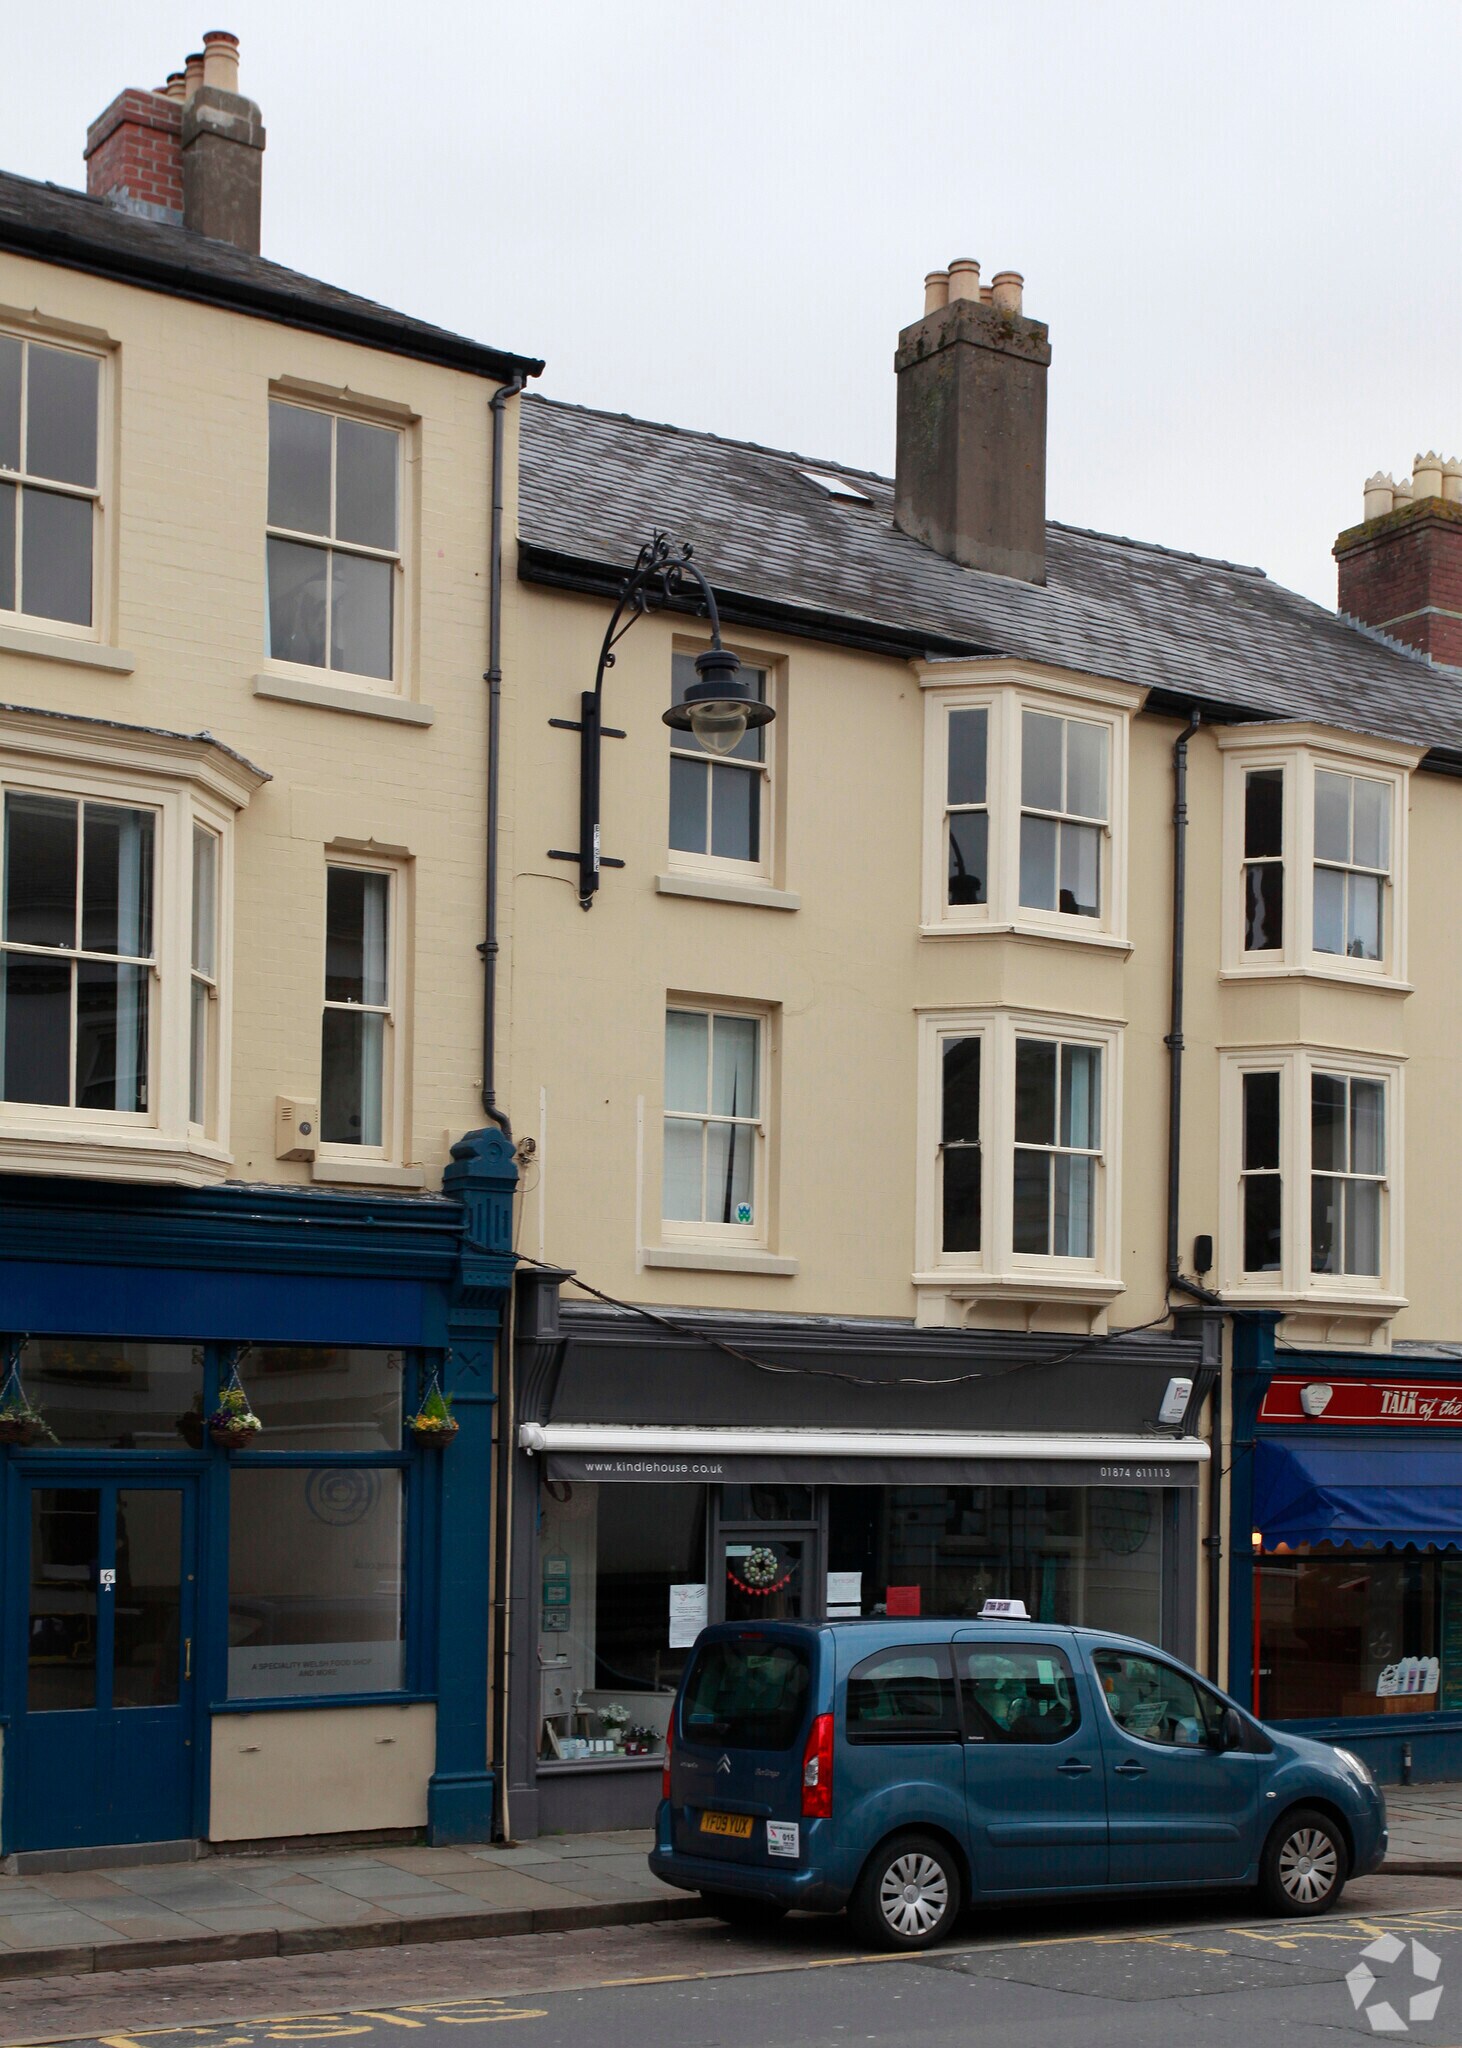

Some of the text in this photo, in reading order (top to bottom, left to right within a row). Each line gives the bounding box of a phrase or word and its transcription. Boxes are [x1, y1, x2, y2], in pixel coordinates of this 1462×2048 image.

[1381, 1391, 1462, 1421] TALK of the
[585, 1461, 723, 1474] www.kindlehouse.co.uk
[1100, 1467, 1171, 1478] 01874 611113
[104, 1570, 112, 1582] 6
[104, 1583, 111, 1591] A
[258, 1661, 301, 1669] SPECIALITY
[302, 1659, 331, 1668] WELSH
[330, 1659, 351, 1667] FOOD
[298, 1668, 338, 1677] AND MORE
[705, 1813, 750, 1834] YF09 YUX
[782, 1833, 795, 1842] 015
